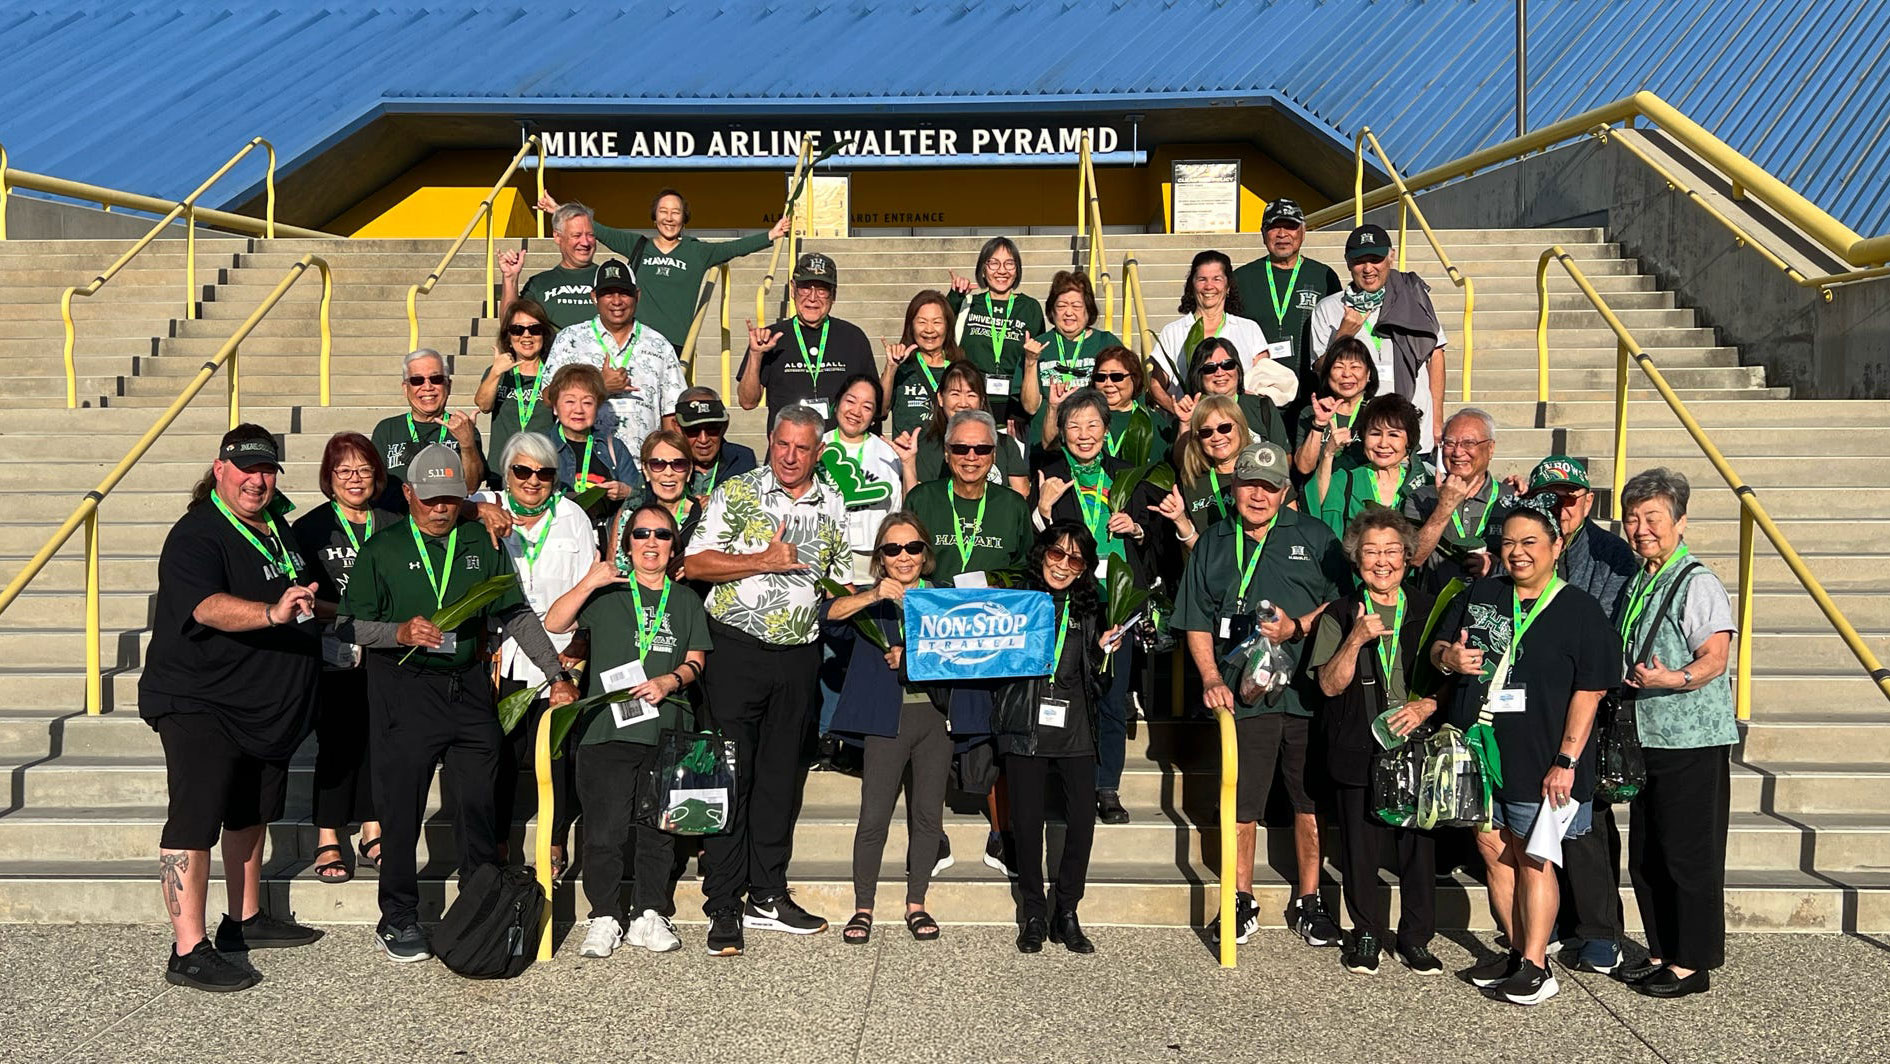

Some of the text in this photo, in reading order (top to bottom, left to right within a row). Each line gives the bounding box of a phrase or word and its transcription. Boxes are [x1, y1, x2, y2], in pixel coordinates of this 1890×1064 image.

[541, 127, 1118, 157] MIKE AND ARLINE WALTER PYRAMID
[884, 212, 945, 223] ENTRANCE
[919, 613, 1028, 638] NON-STOP
[928, 639, 1016, 650] TRAVEL
